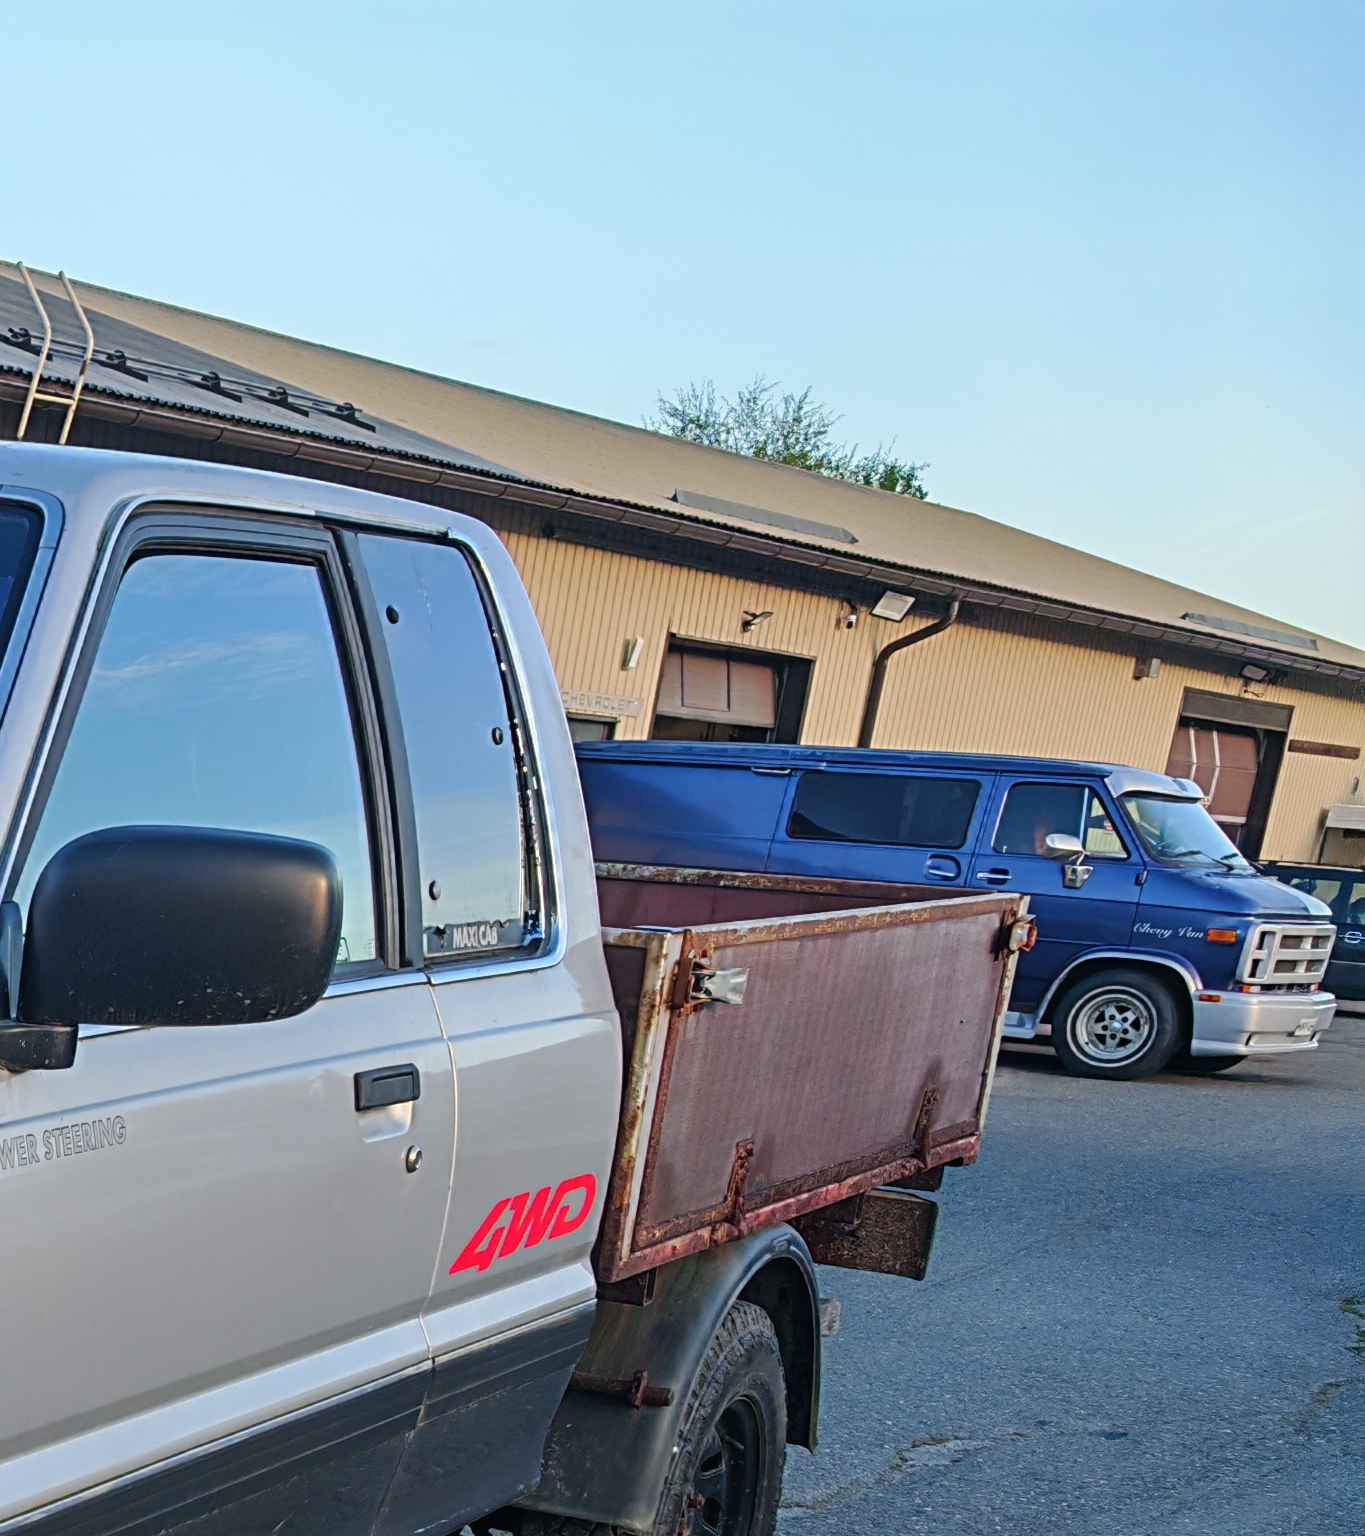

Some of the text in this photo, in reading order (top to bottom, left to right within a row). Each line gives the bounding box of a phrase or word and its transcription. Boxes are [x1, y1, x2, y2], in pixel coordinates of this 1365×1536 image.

[453, 924, 498, 949] MAXI CAB
[1133, 922, 1204, 939] Chevy Van
[42, 1115, 127, 1161] STEERING
[448, 1173, 598, 1275] 4WD
